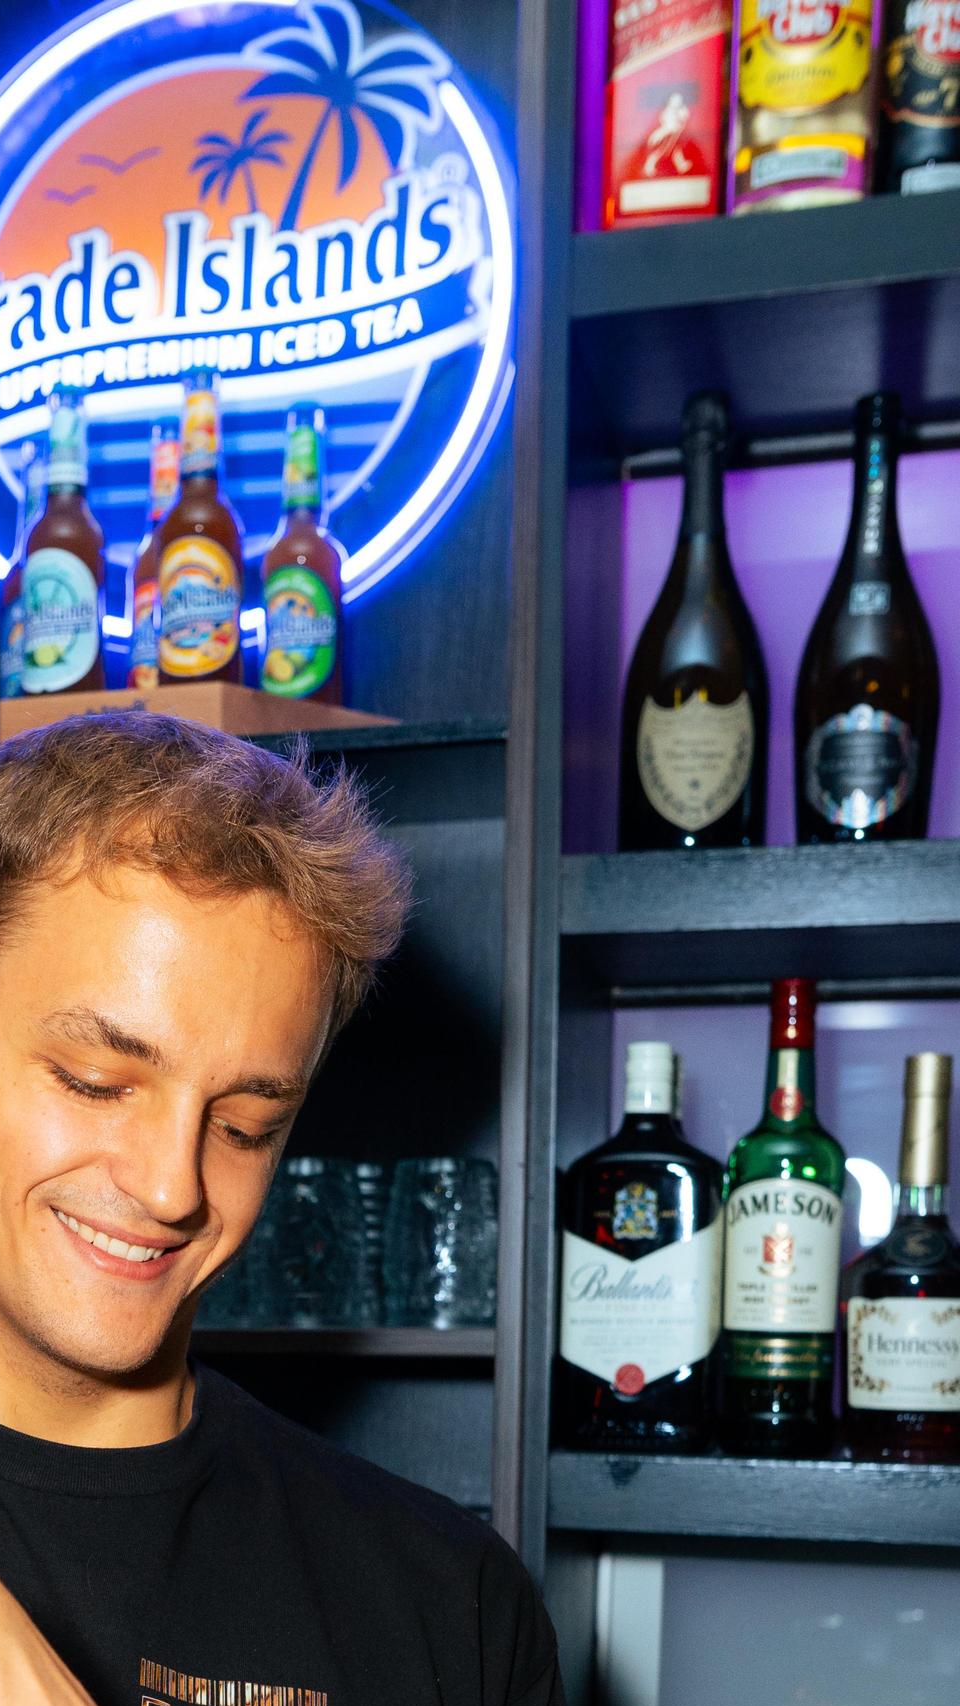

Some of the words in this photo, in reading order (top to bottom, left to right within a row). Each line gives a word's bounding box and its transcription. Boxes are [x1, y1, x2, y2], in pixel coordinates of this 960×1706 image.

[174, 183, 456, 320] Islands
[259, 314, 347, 367] ICED
[351, 298, 424, 348] TEA
[726, 1190, 838, 1227] JAMESON
[867, 1332, 959, 1357] Hennessy
